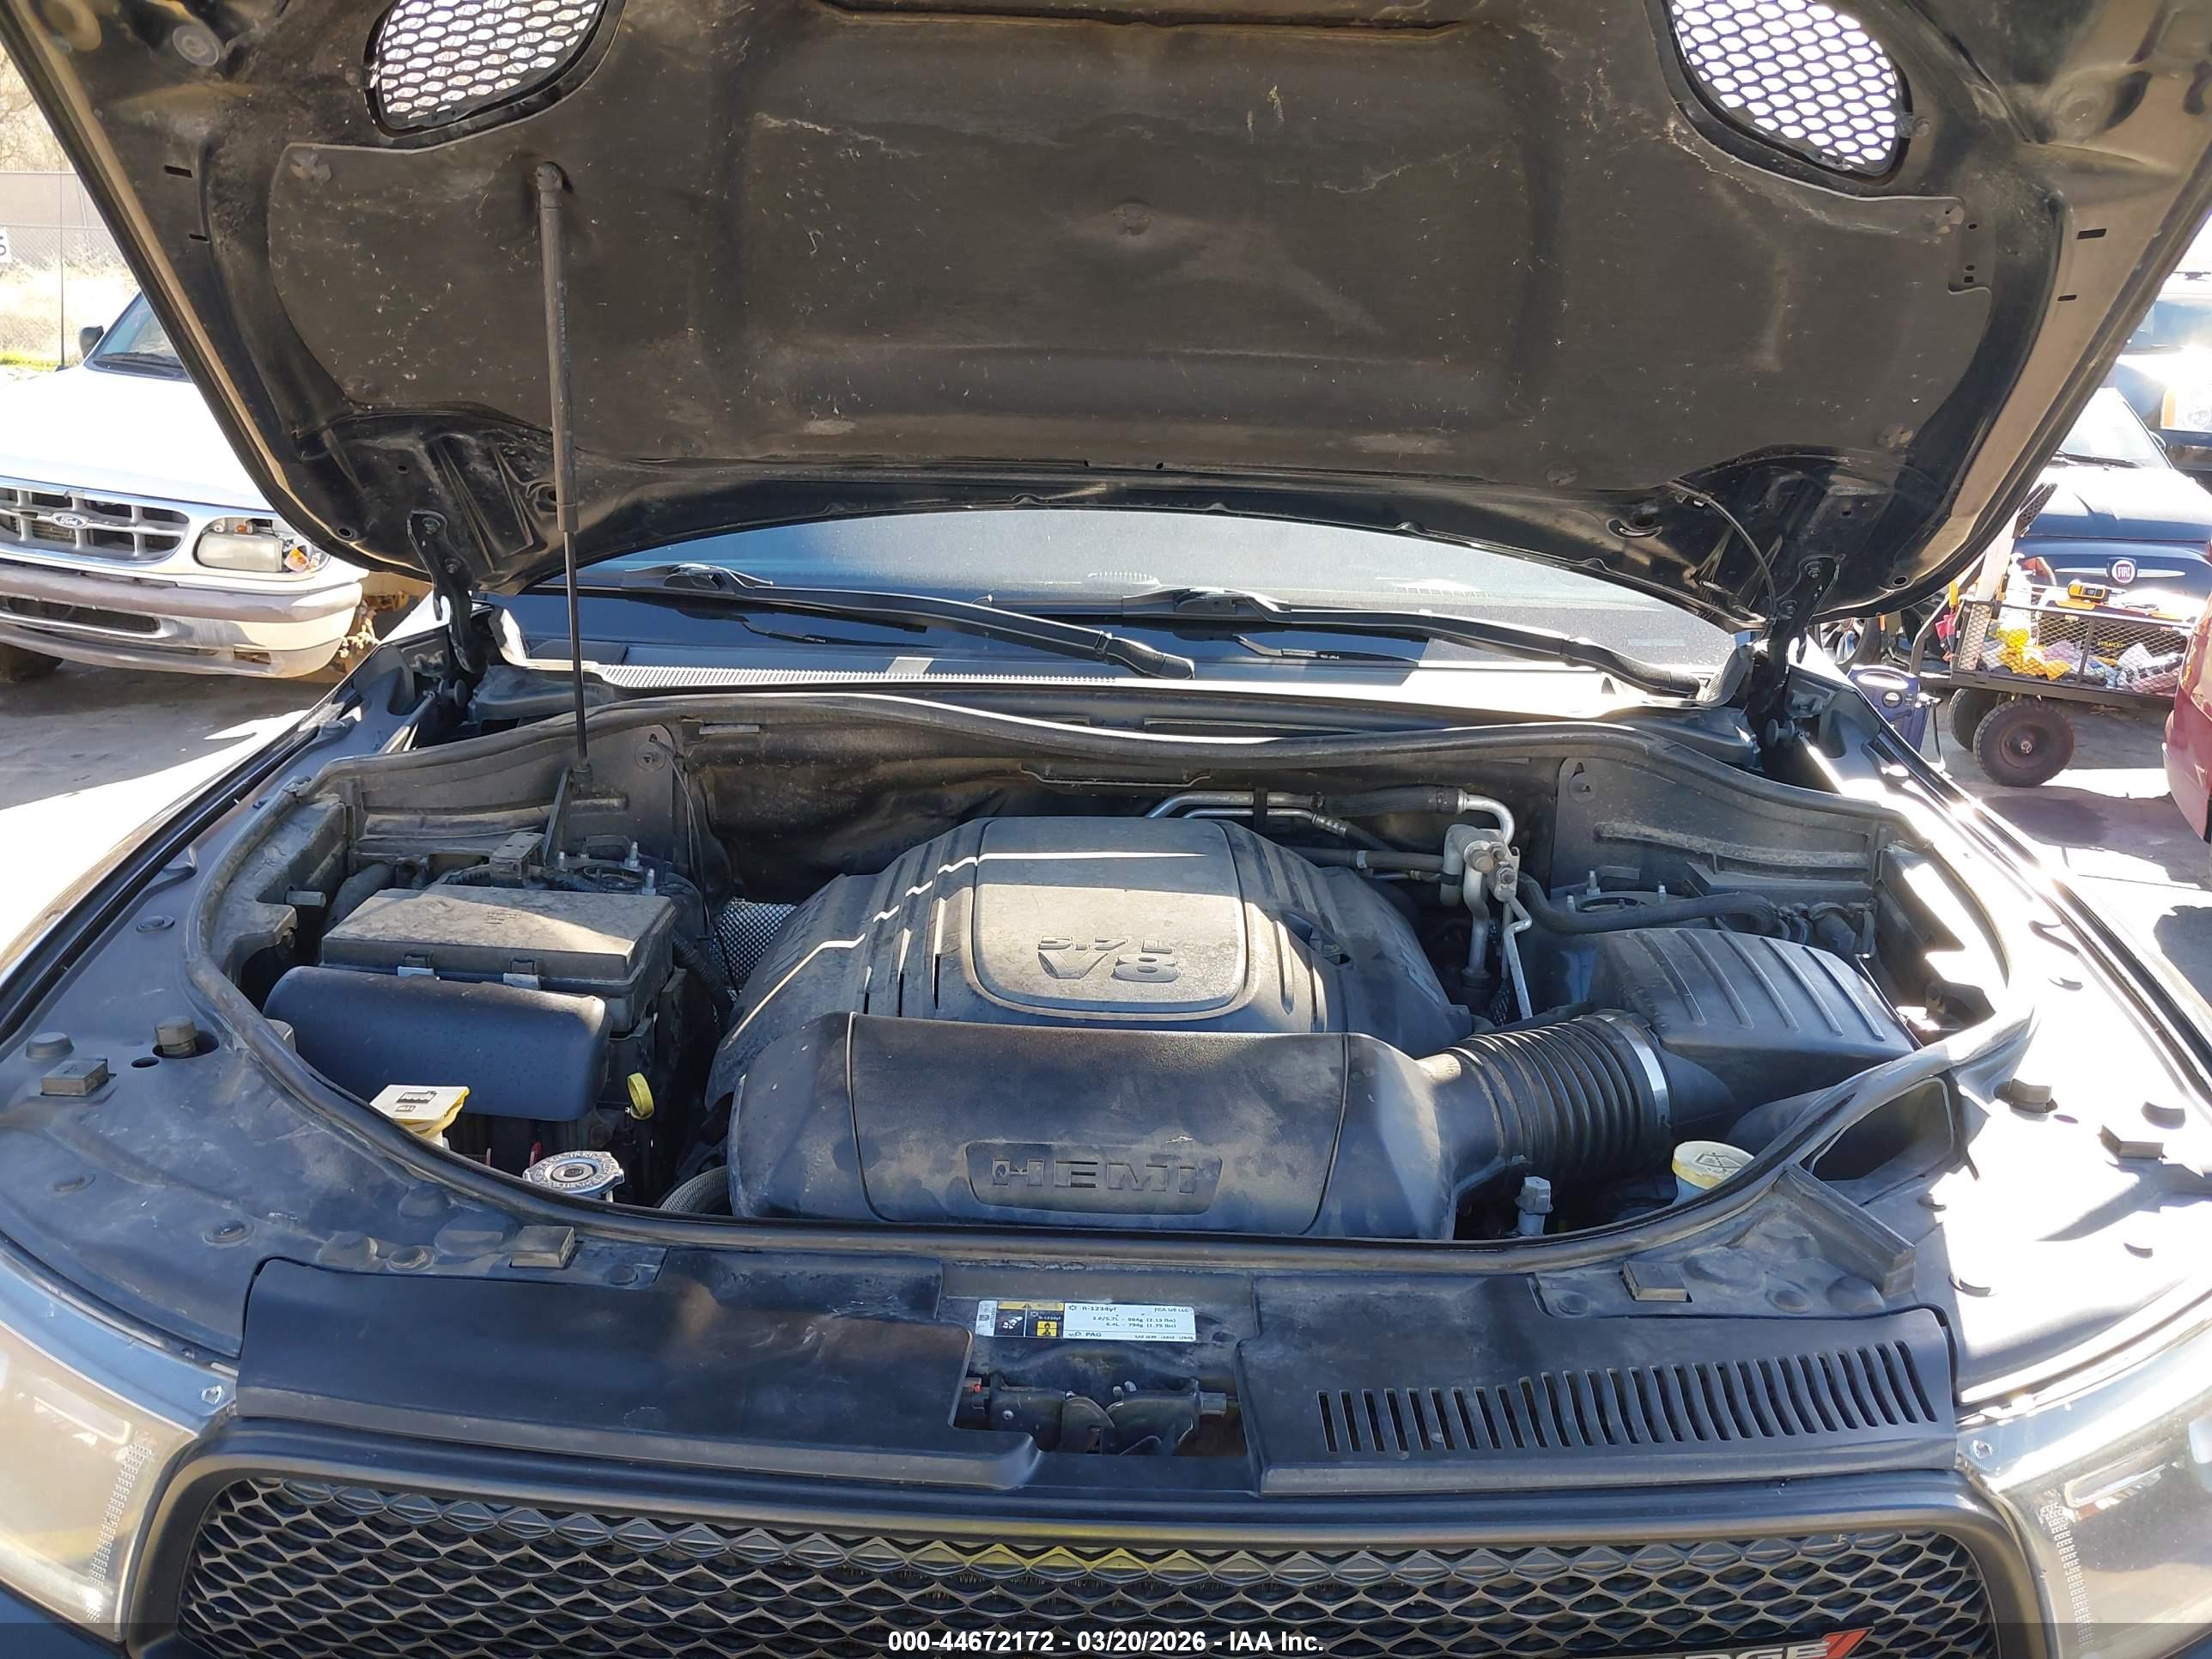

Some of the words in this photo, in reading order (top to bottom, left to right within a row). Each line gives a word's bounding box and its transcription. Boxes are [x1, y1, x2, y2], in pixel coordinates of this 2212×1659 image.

[2118, 567, 2131, 578] FIAT
[1037, 951, 1180, 983] V8
[993, 1159, 1197, 1194] HEMI
